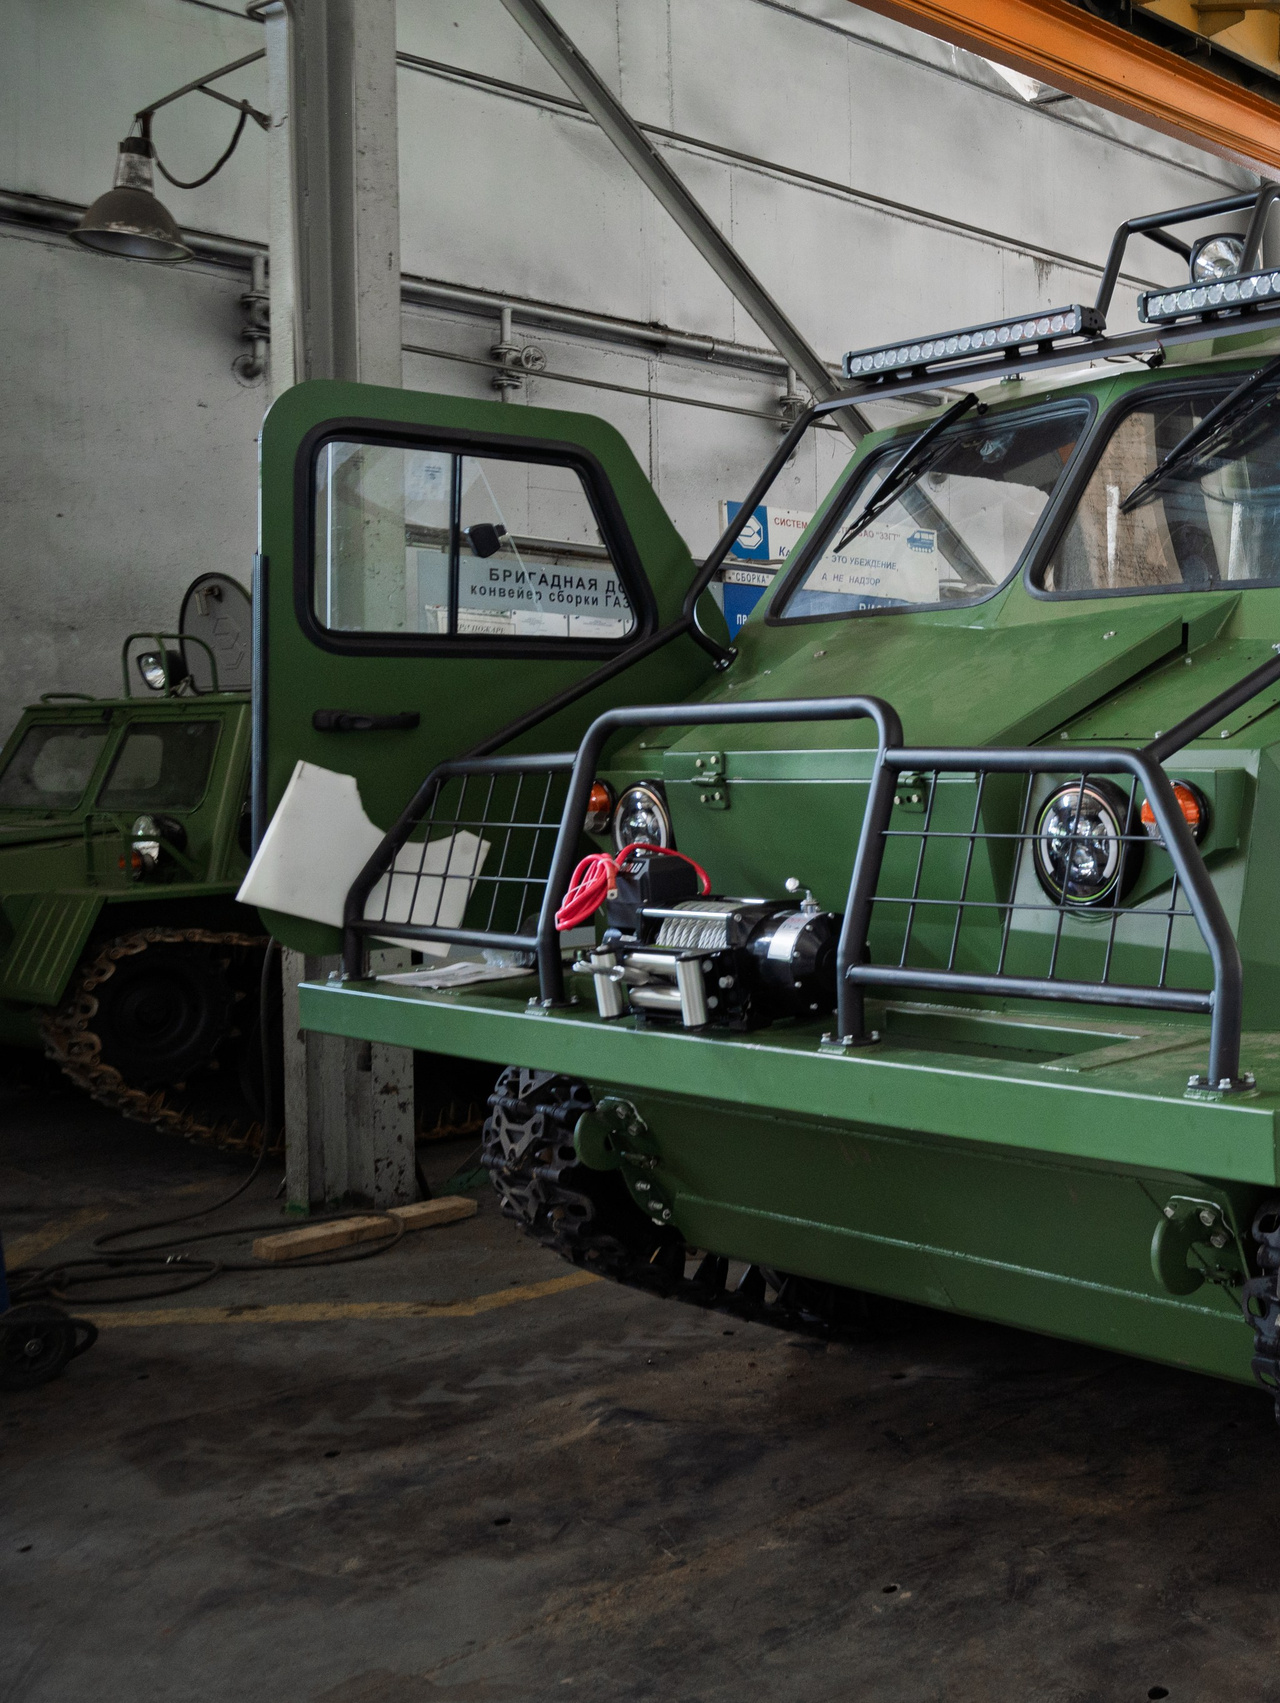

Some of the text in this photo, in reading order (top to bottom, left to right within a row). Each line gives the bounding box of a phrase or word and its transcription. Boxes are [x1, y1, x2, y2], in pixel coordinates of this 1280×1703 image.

[774, 516, 809, 530] СИСТЕМ
[831, 555, 848, 564] ЭТО
[489, 568, 598, 591] БРИГАДНАЯ
[821, 572, 828, 581] А
[832, 574, 844, 583] НЕ
[470, 584, 542, 604] конвейер
[548, 590, 599, 607] сборки
